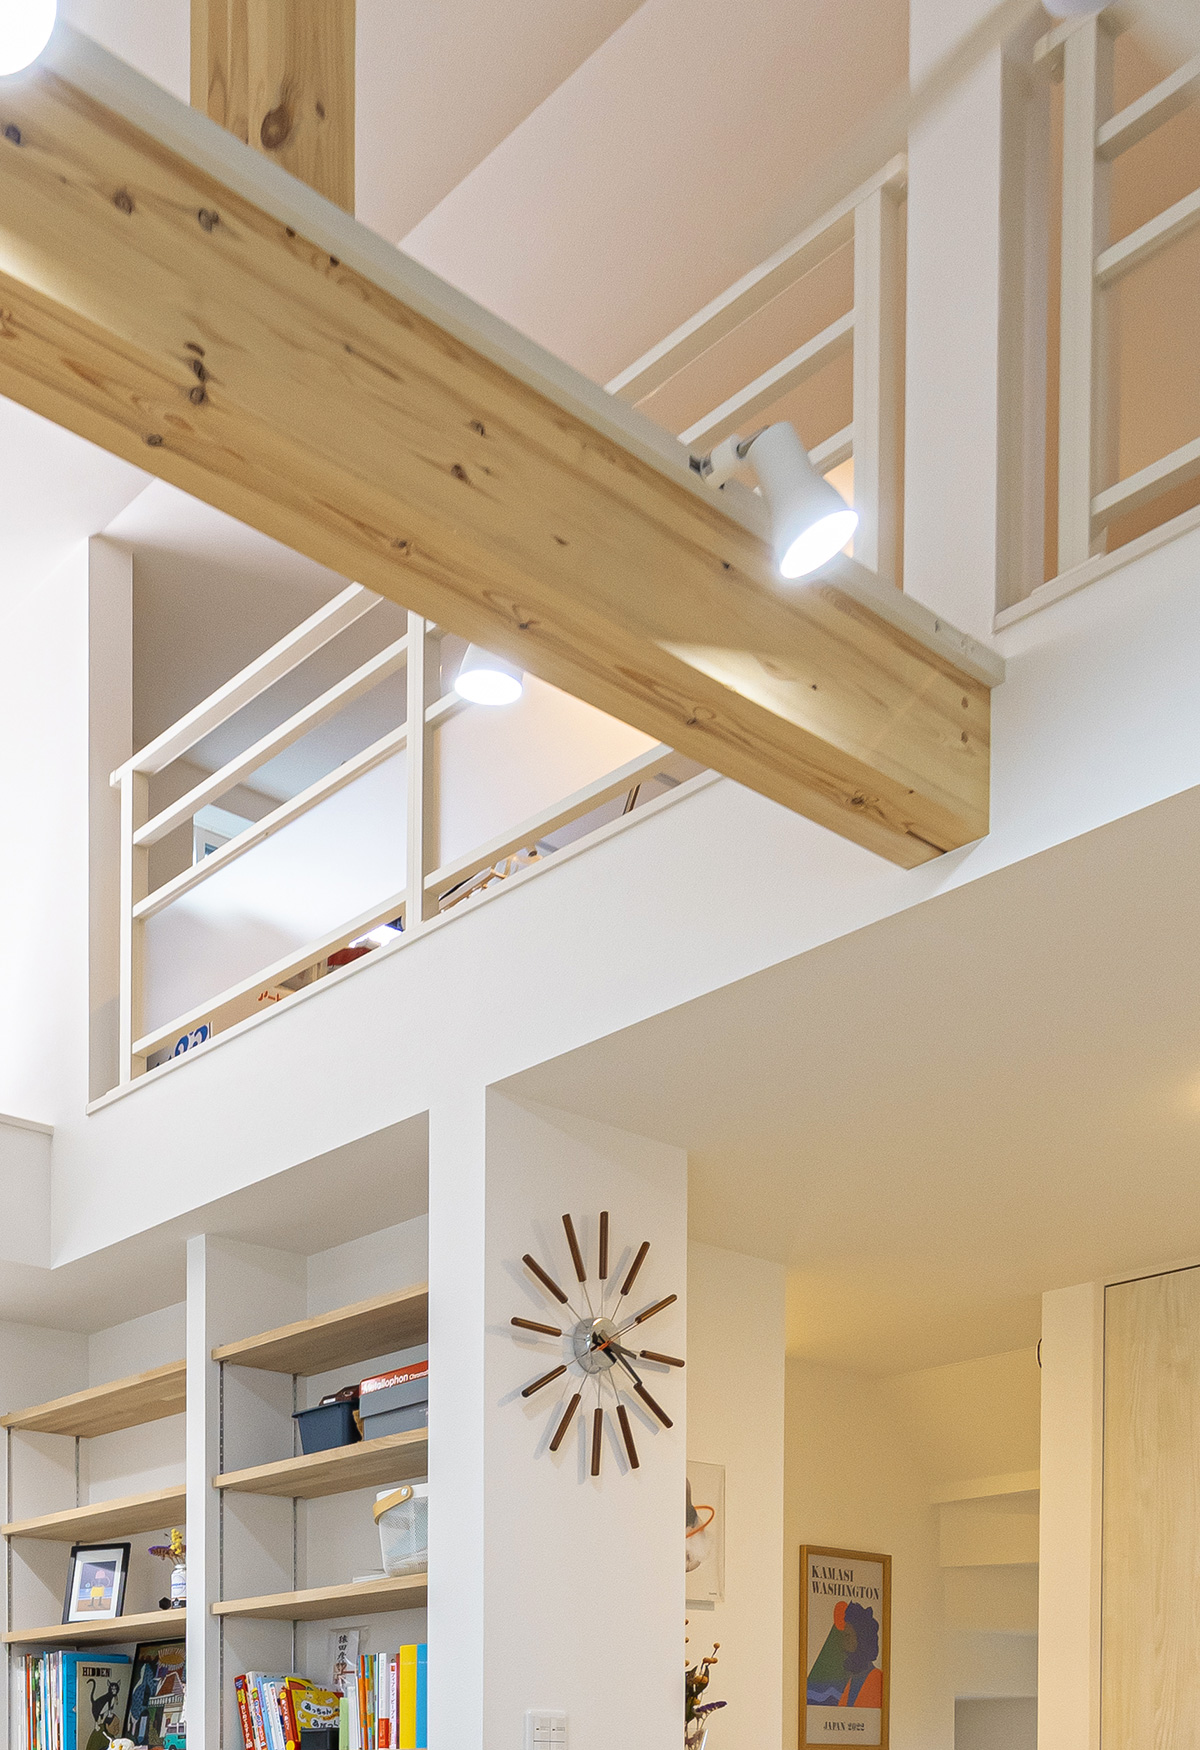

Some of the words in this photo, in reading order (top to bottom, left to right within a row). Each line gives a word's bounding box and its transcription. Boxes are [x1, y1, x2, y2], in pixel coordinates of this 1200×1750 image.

[811, 1565, 854, 1582] KAMASI
[812, 1581, 880, 1600] WASHINGTON
[823, 1721, 846, 1731] JAPAN
[847, 1722, 865, 1731] 2022
